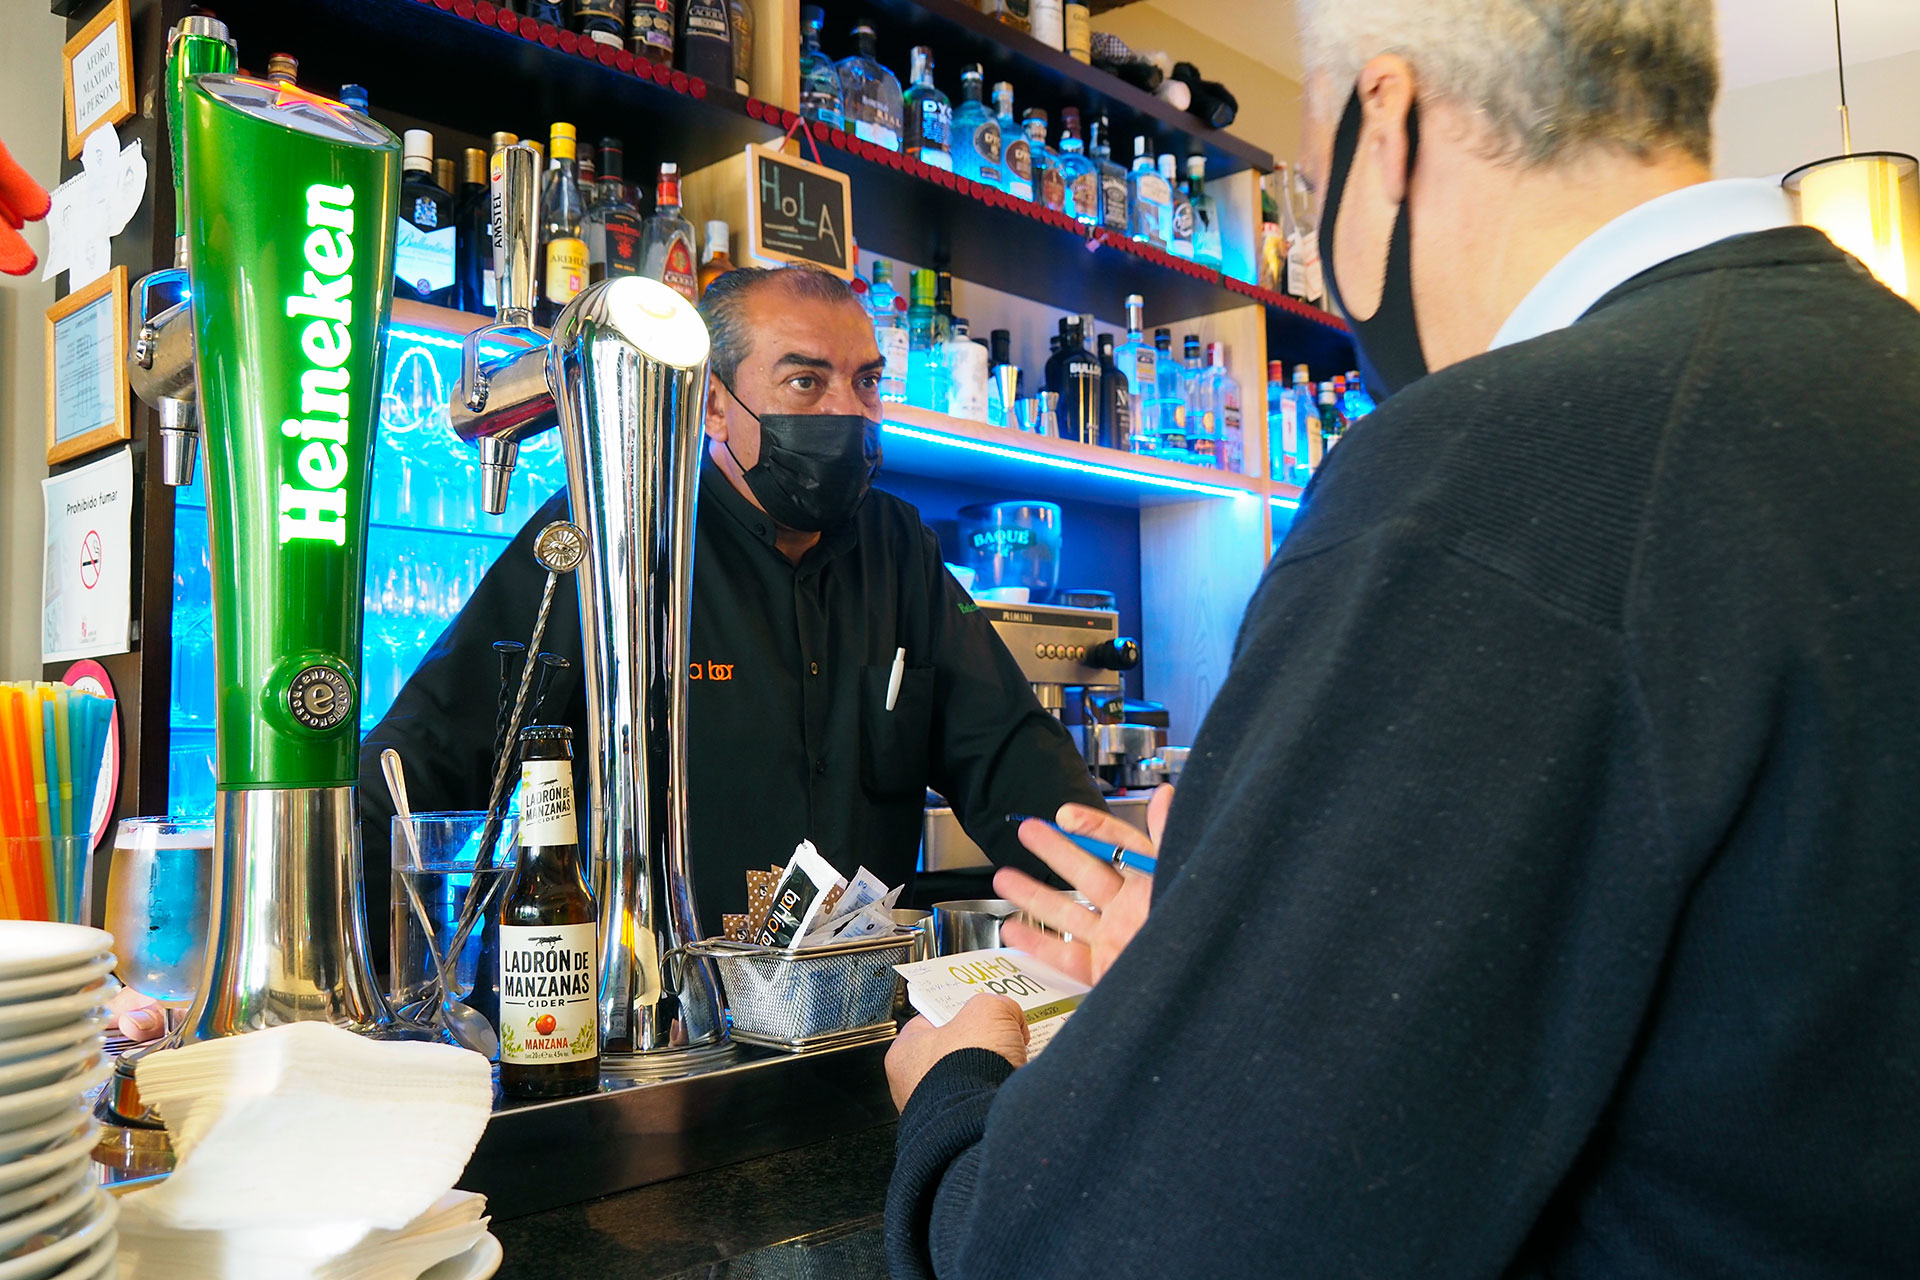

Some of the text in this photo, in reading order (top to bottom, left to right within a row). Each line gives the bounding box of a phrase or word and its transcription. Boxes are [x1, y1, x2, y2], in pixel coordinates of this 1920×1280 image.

[87, 43, 110, 73] AFORO
[85, 80, 120, 117] PERSONA
[492, 192, 503, 248] AMSTEL
[279, 183, 355, 547] Heineken
[66, 489, 119, 516] Prohibido fumar
[1002, 610, 1033, 623] RIMINI
[525, 784, 571, 808] LADRÓN DE
[525, 798, 571, 823] MANZANAS
[537, 814, 560, 825] CIDER
[504, 945, 589, 973] LADRÓN DE
[504, 972, 590, 998] MANZANAS
[984, 973, 1046, 997] pon
[528, 999, 566, 1009] CIDER
[525, 1037, 569, 1051] MANZANA
